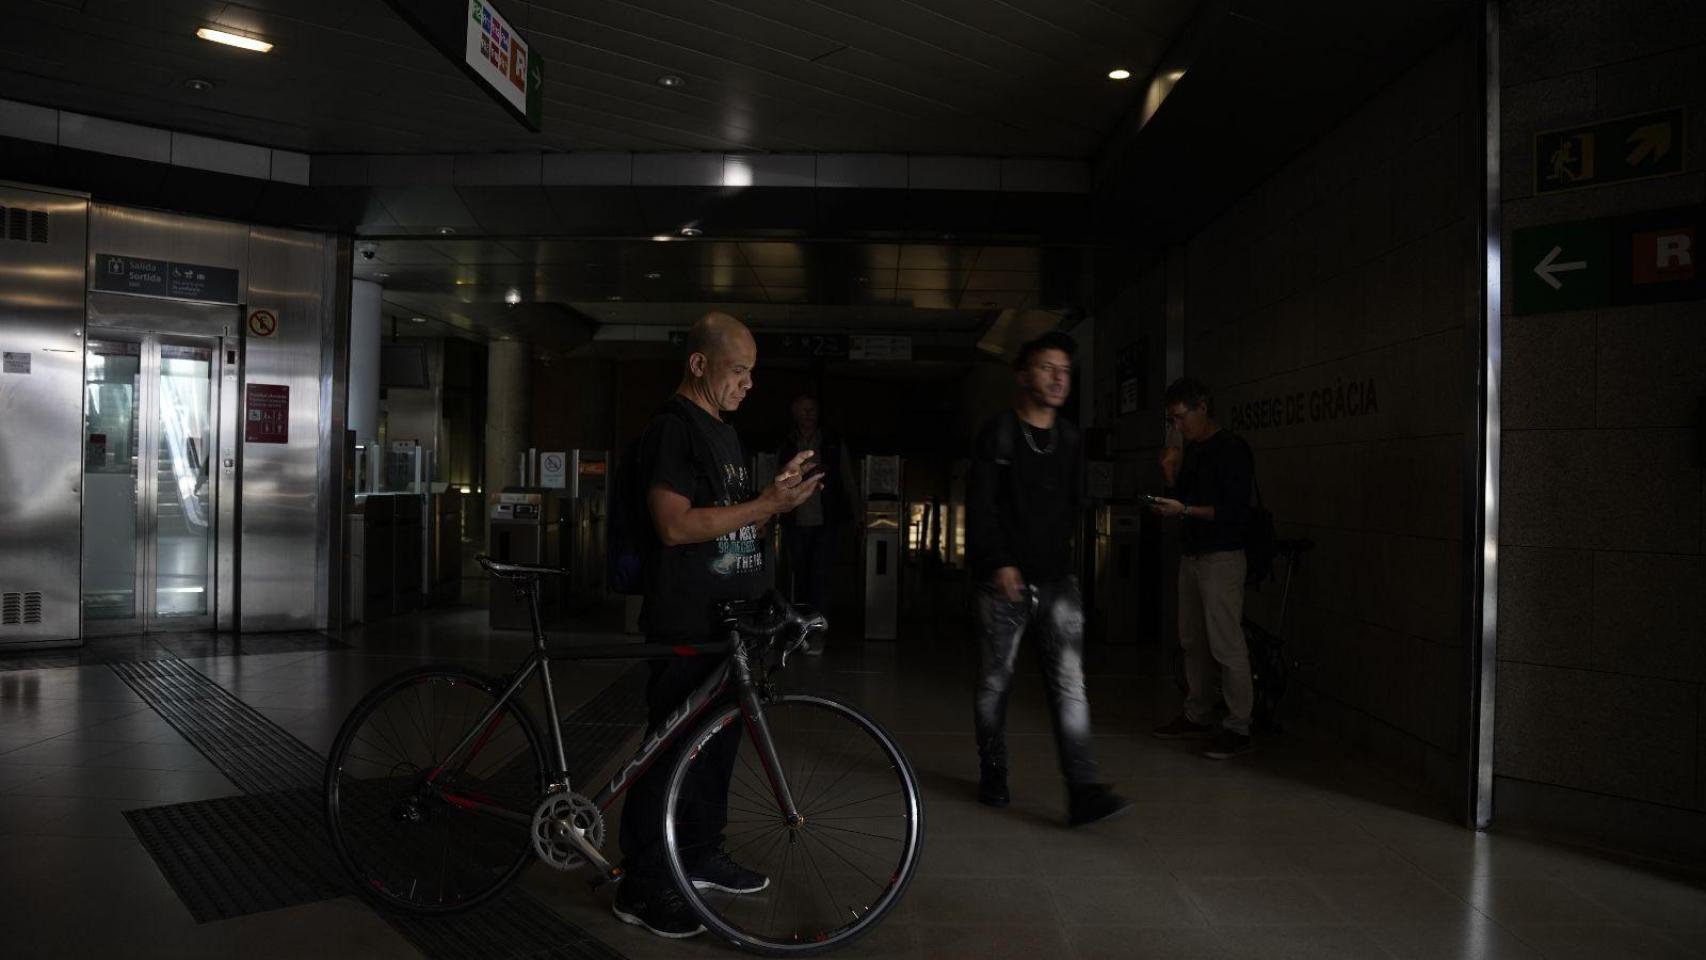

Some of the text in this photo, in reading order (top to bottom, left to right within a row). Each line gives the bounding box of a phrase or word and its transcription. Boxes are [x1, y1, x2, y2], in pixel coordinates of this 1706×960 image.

[1656, 232, 1692, 268] R
[129, 262, 157, 273] Salida
[129, 271, 162, 283] Sortida
[1231, 377, 1378, 430] PASSEIG DE GRÀCIA
